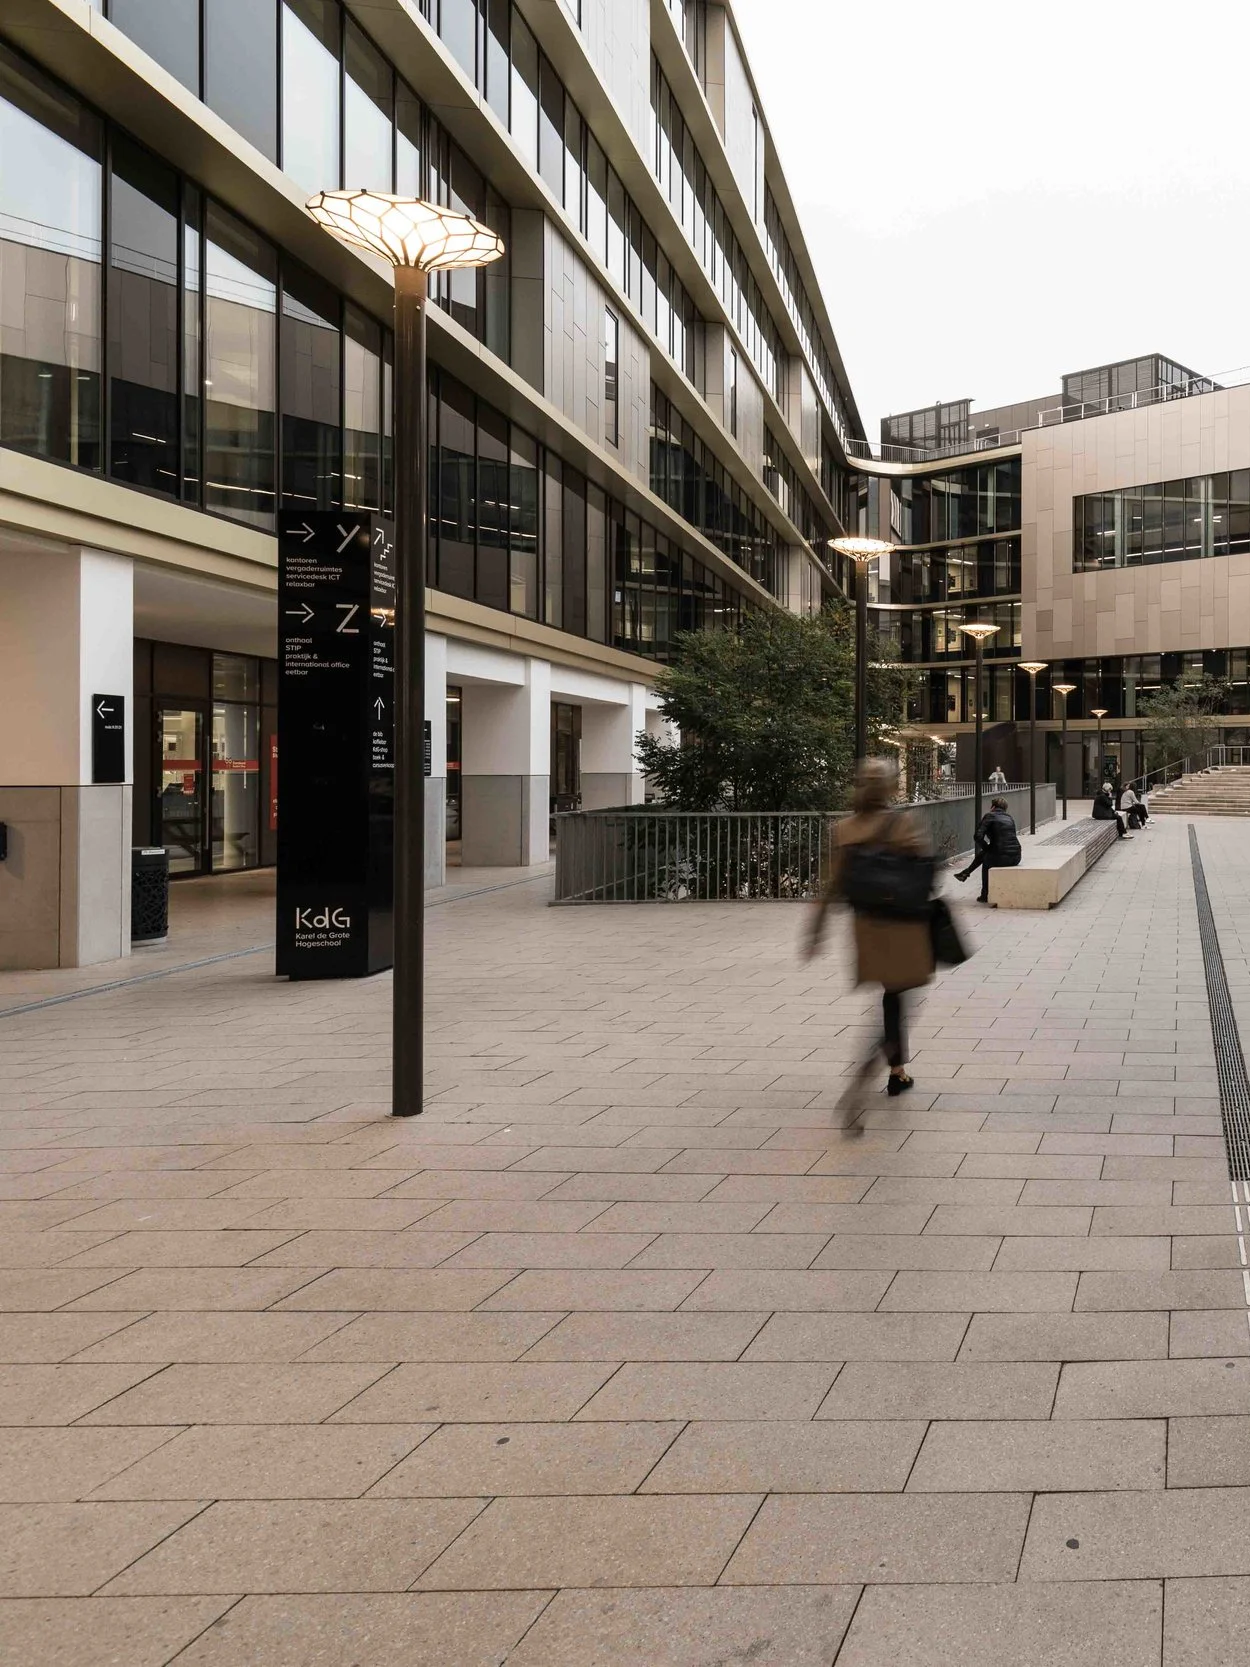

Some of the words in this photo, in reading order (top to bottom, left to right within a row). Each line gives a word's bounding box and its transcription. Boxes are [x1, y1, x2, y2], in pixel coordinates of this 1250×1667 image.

[337, 524, 360, 553] Y
[336, 604, 359, 633] Z
[286, 653, 311, 661] praktijk
[296, 907, 350, 929] KdG
[296, 940, 341, 948] Hogeschool
